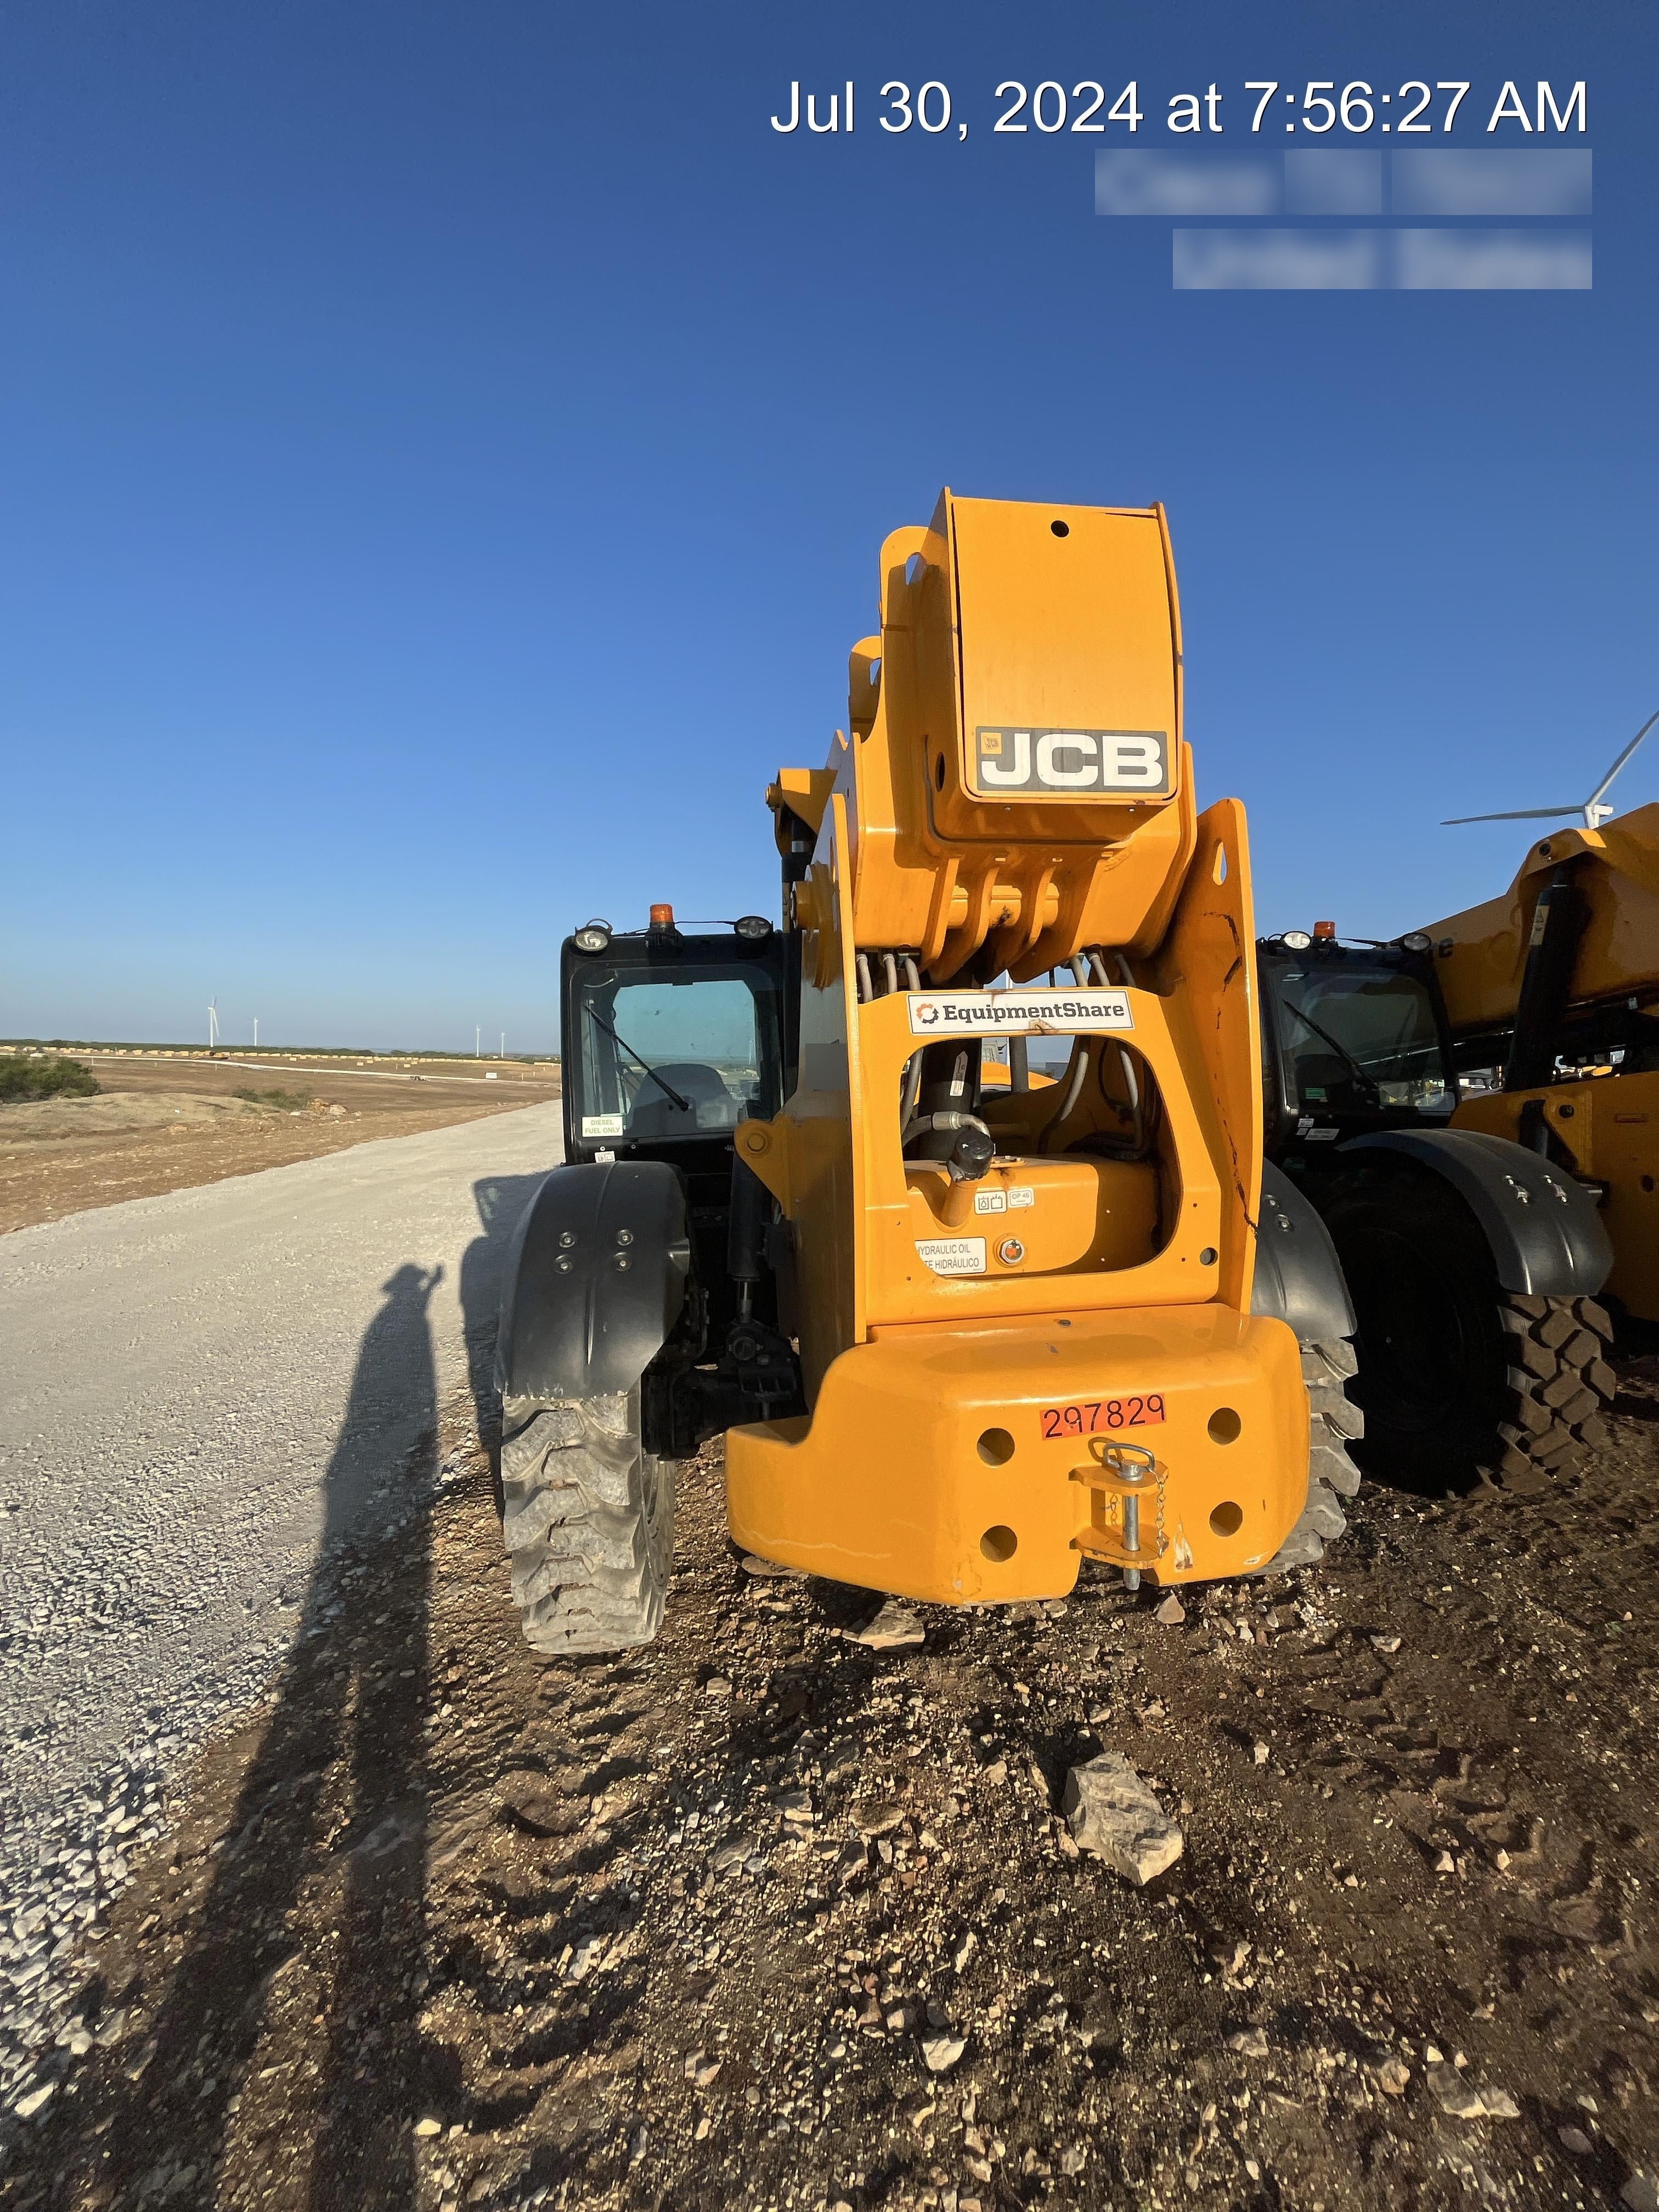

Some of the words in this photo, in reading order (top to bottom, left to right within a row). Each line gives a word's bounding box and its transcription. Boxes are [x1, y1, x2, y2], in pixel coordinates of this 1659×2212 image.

[981, 732, 1164, 787] JCB
[943, 1002, 1125, 1023] EquipmentShare
[958, 1244, 970, 1254] OIL
[935, 1257, 979, 1269] HIDRÁULICO
[1043, 1394, 1165, 1438] 297829
